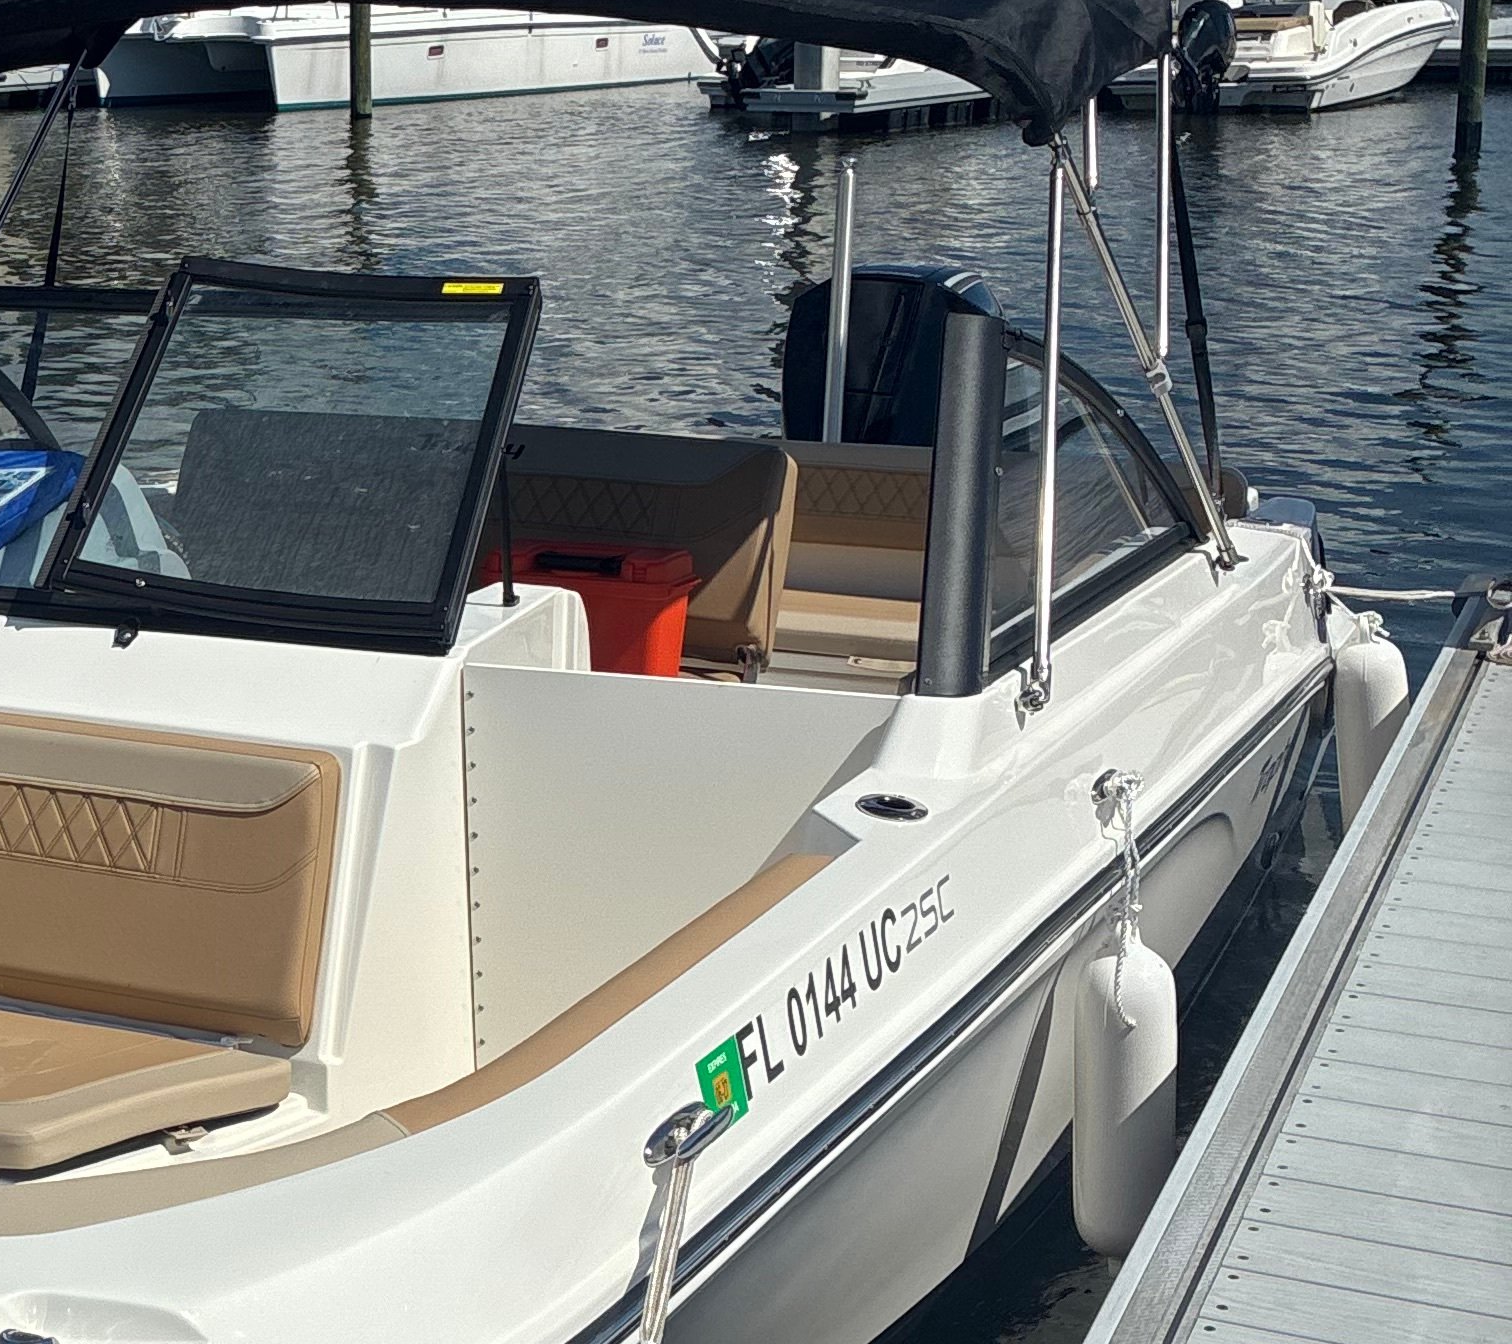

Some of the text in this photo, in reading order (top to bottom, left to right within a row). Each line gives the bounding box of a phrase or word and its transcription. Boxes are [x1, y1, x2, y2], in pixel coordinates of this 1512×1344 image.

[900, 873, 955, 954] 25C
[735, 907, 902, 1102] FL 0144 UC
